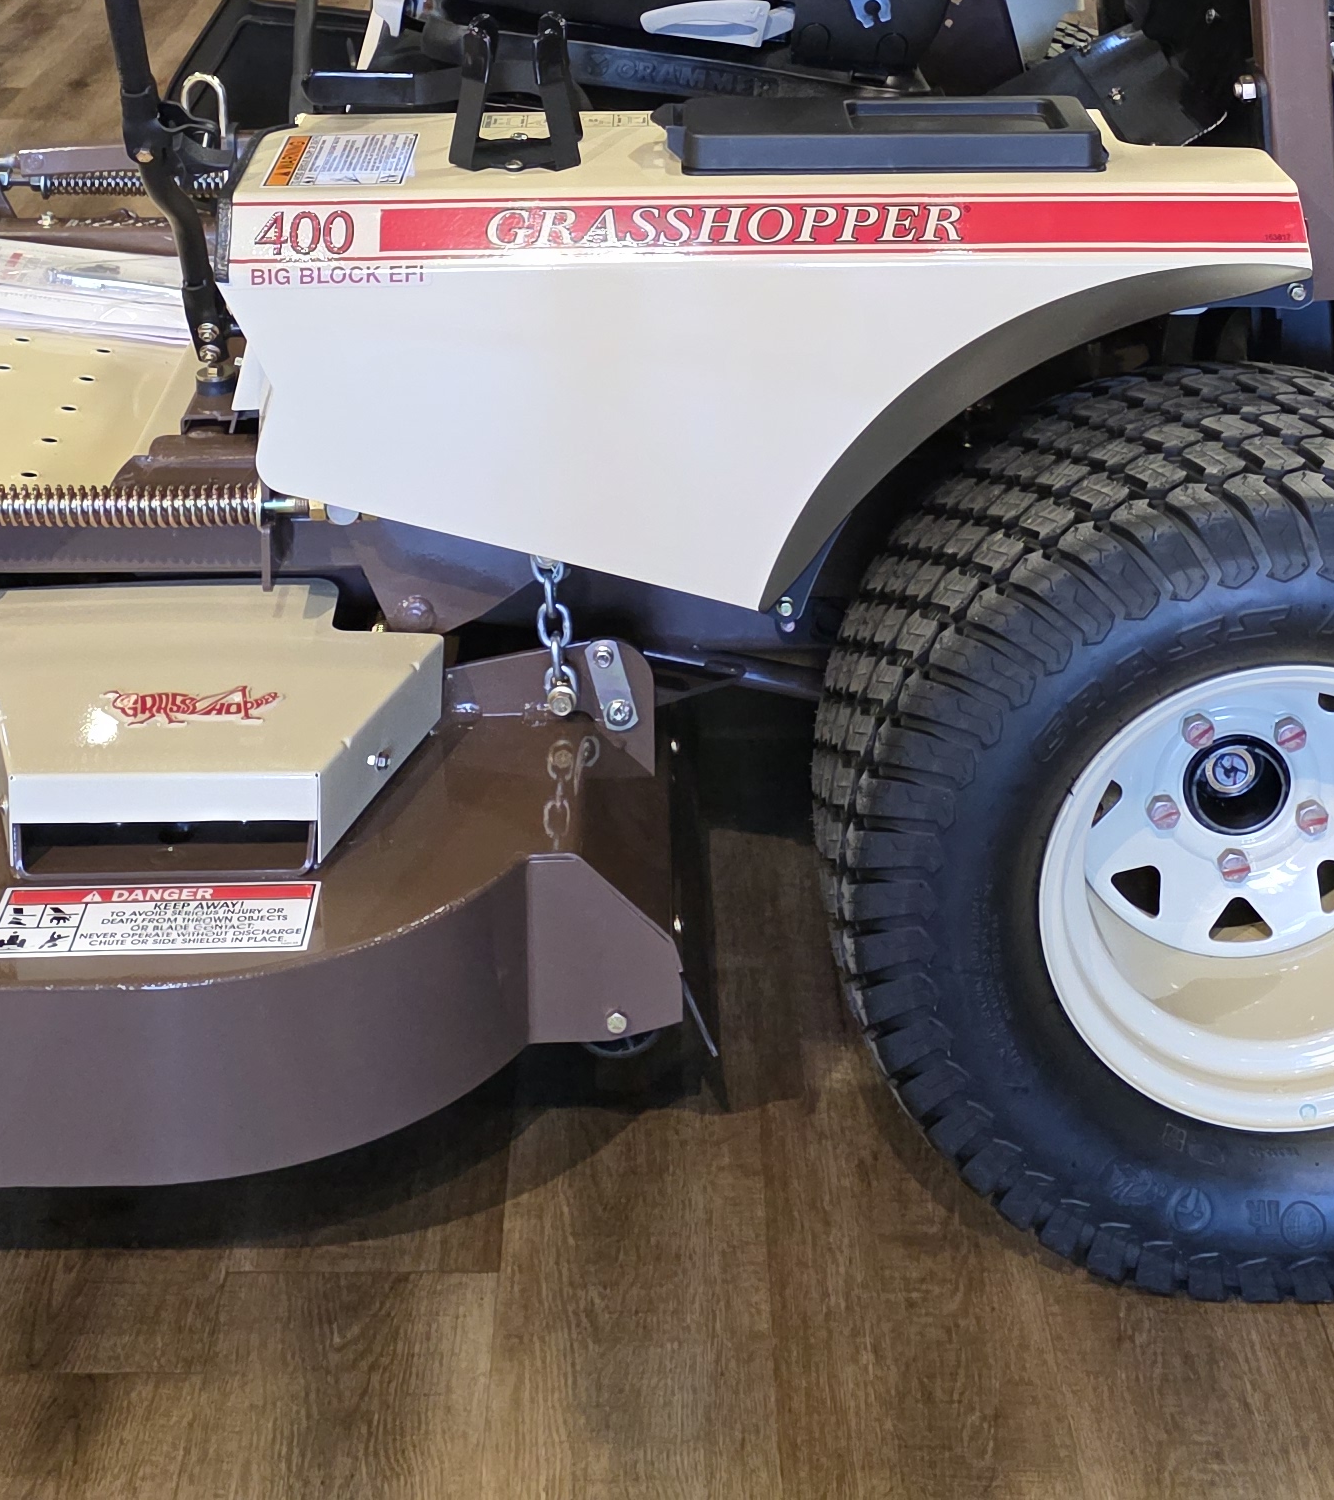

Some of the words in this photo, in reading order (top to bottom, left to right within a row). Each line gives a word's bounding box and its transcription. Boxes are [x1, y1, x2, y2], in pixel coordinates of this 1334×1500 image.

[253, 209, 355, 255] 400
[485, 203, 964, 248] GRASSHOPPER
[250, 267, 291, 286] BIG
[299, 265, 382, 285] BLOCK
[389, 264, 425, 283] EFI
[108, 685, 282, 726] GRASSHOPPER
[111, 887, 214, 901] DANGER
[153, 902, 191, 911] KEEP
[193, 900, 244, 910] AWAY!
[181, 916, 233, 924] THROWN
[237, 914, 288, 923] OBJECTS
[130, 924, 149, 932] OR
[152, 923, 189, 931] BLADE
[120, 931, 172, 939] OPERATE
[177, 930, 229, 938] WITHOUT
[232, 928, 302, 936] DISCHARGE
[246, 935, 287, 943] PLACE.
